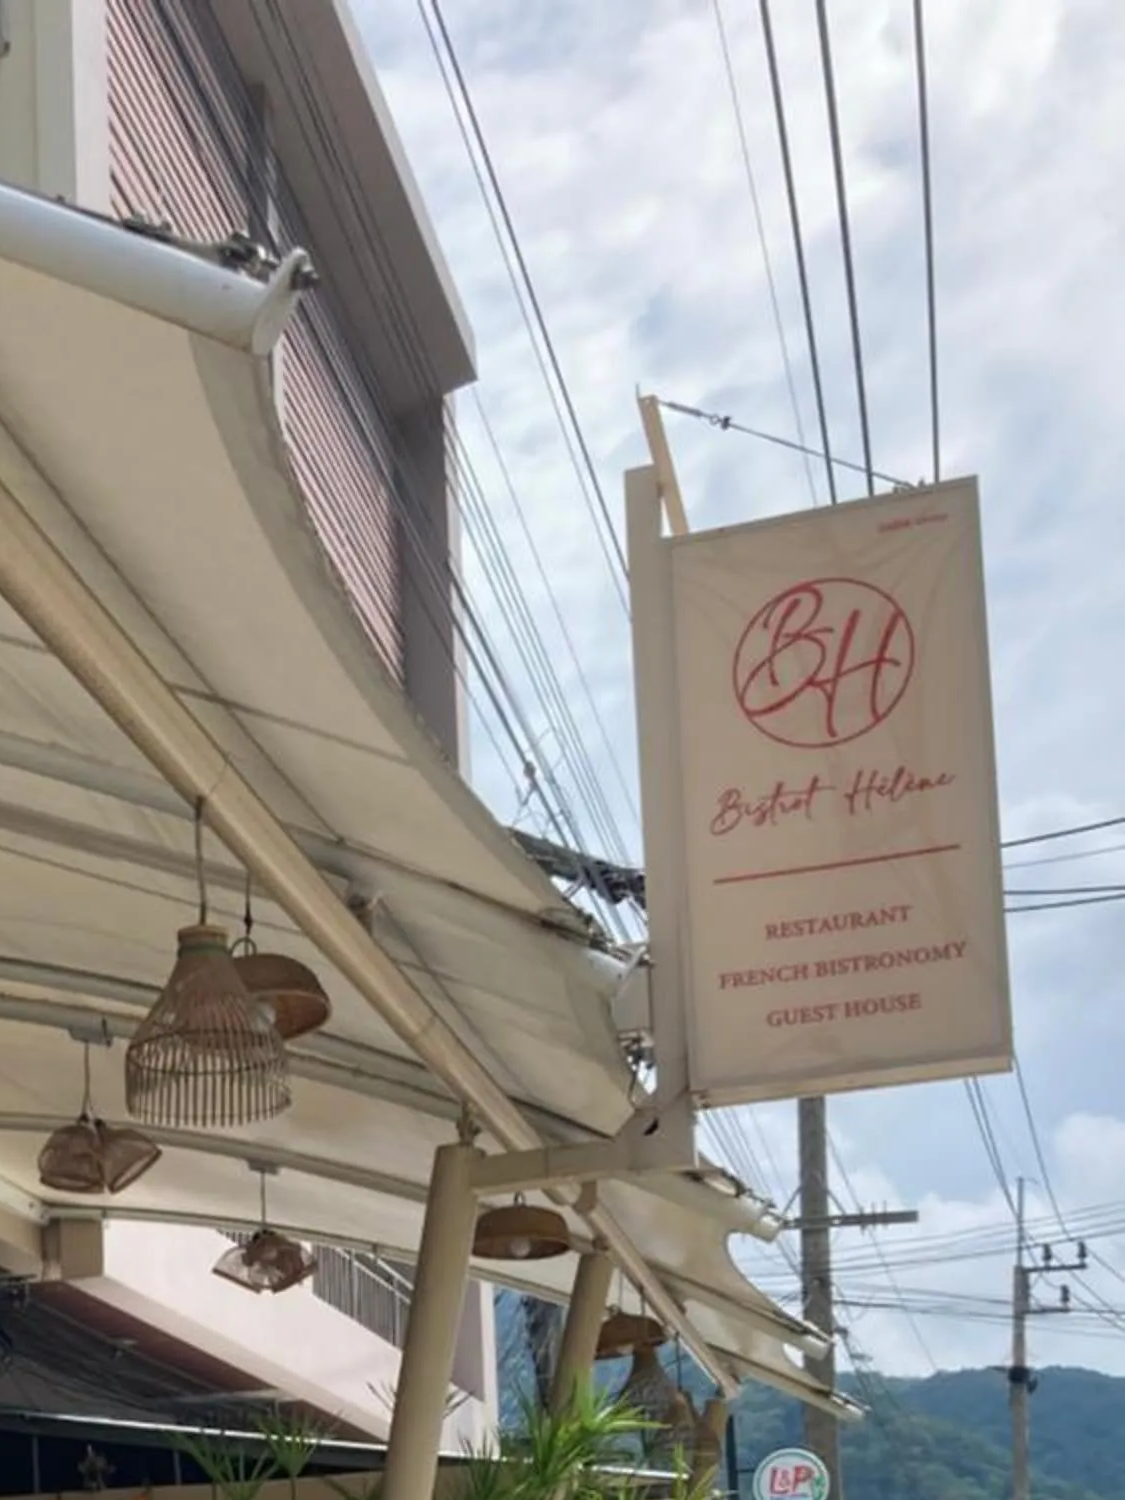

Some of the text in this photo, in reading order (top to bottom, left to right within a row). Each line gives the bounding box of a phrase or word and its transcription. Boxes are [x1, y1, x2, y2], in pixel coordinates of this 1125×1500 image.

[710, 775, 836, 836] Bistrot
[764, 904, 913, 940] RESTAURANT
[718, 941, 967, 990] FRENCH BISTRONOMY
[766, 993, 922, 1028] GUEST HOUSE
